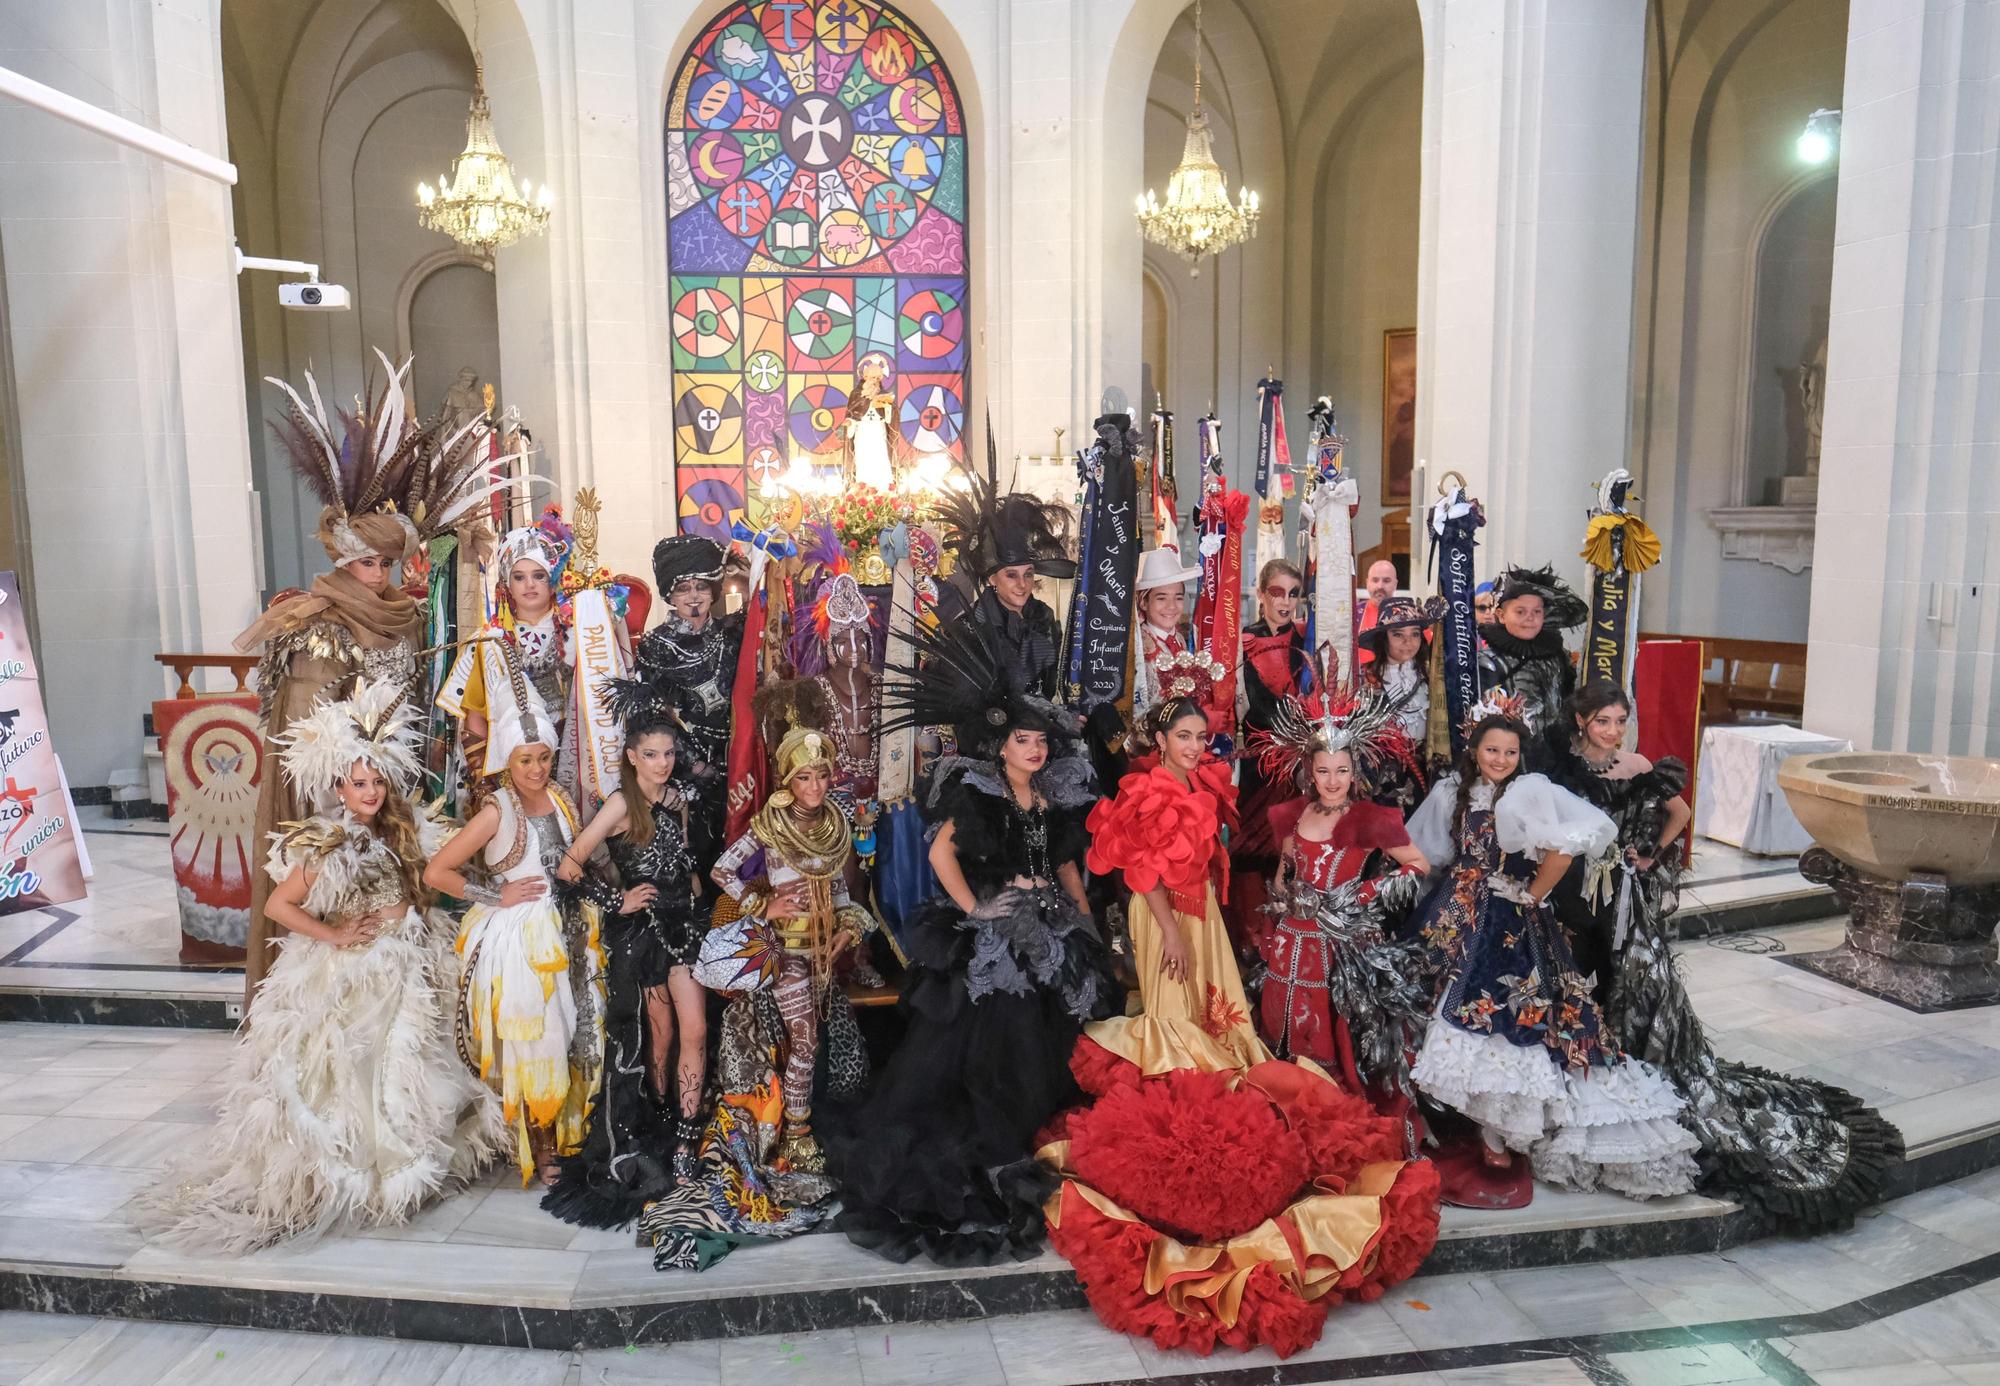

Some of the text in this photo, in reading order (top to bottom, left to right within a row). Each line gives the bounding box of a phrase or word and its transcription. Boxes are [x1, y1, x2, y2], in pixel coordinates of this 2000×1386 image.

[1099, 501, 1129, 599] Jaime y María
[1602, 574, 1624, 611] ulia
[1450, 547, 1472, 708] Sofía Cutillas Pér
[1598, 619, 1615, 632] y
[1088, 638, 1125, 657] Infantil
[583, 623, 610, 677] PAULA
[598, 735, 622, 774] 2020
[1091, 681, 1115, 690] 2020
[0, 730, 44, 772] futuro
[1880, 795, 1918, 809] NOMINE
[1920, 798, 1957, 812] PATRIS
[22, 817, 64, 856] unión
